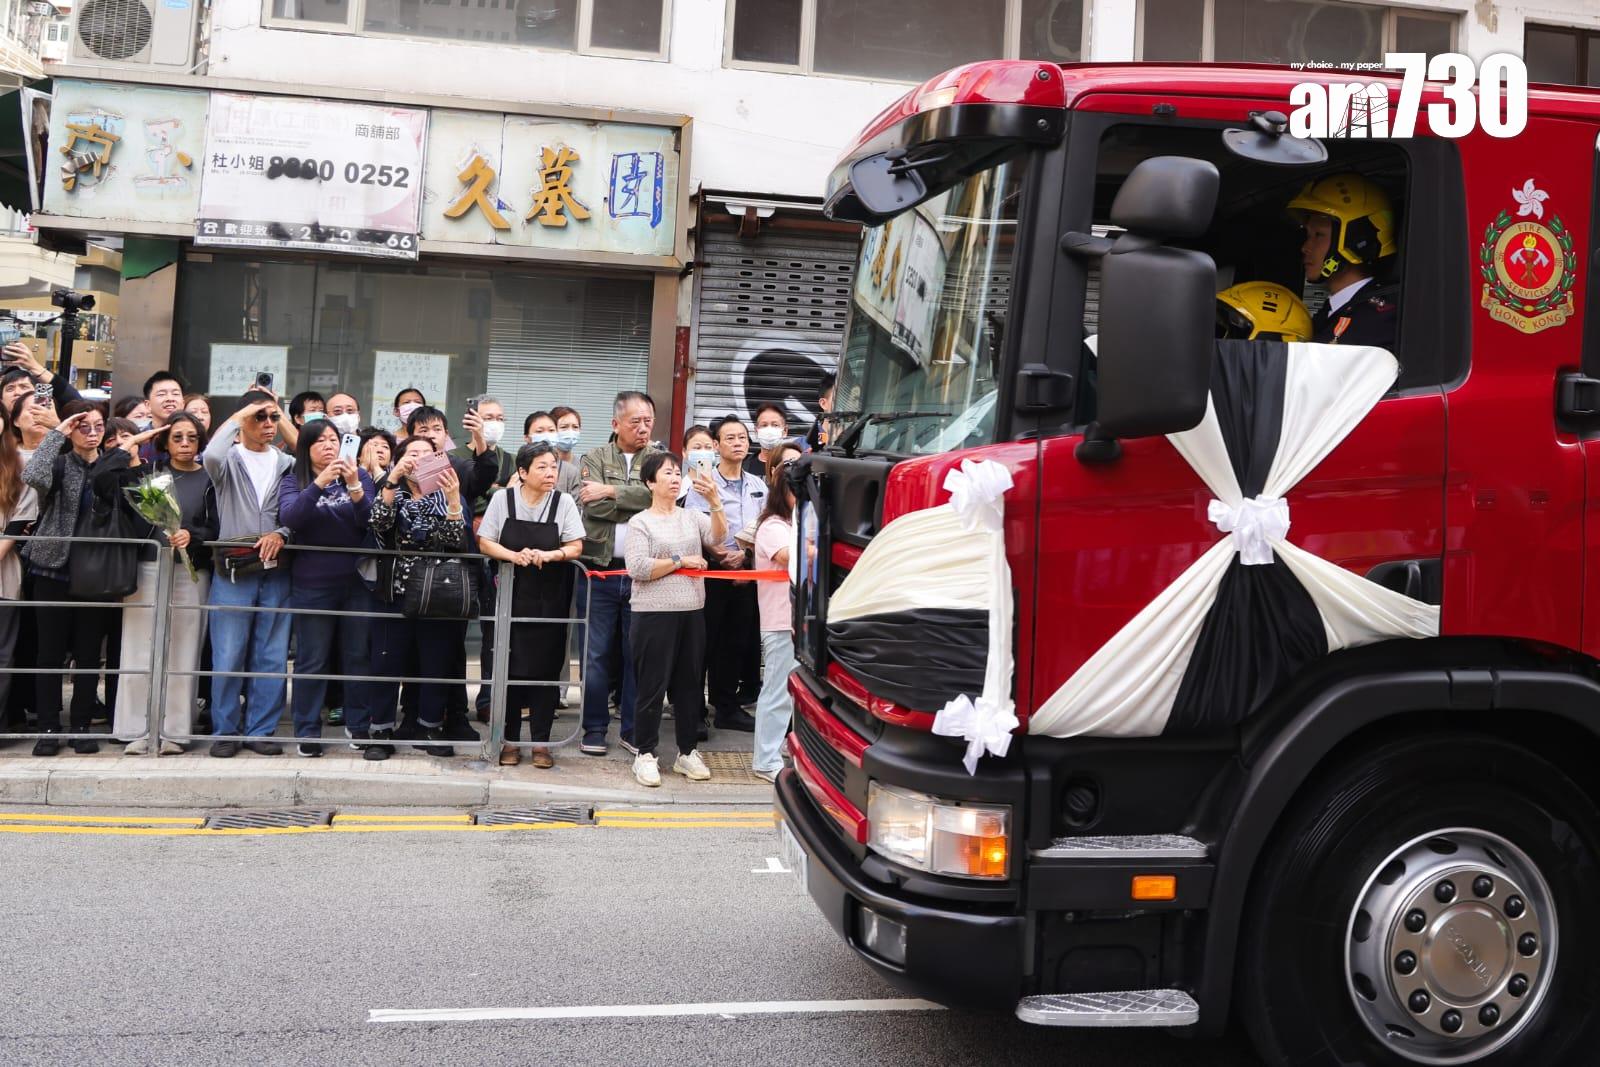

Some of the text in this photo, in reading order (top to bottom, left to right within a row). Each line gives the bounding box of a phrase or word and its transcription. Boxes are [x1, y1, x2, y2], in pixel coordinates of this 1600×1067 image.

[212, 152, 265, 171] 杜小姐
[344, 161, 410, 189] 0252
[300, 225, 351, 242] 210
[1517, 223, 1542, 234] FIRE
[1264, 291, 1280, 300] ST
[1506, 281, 1551, 298] SERVICES
[1493, 307, 1562, 330] HONG KONG
